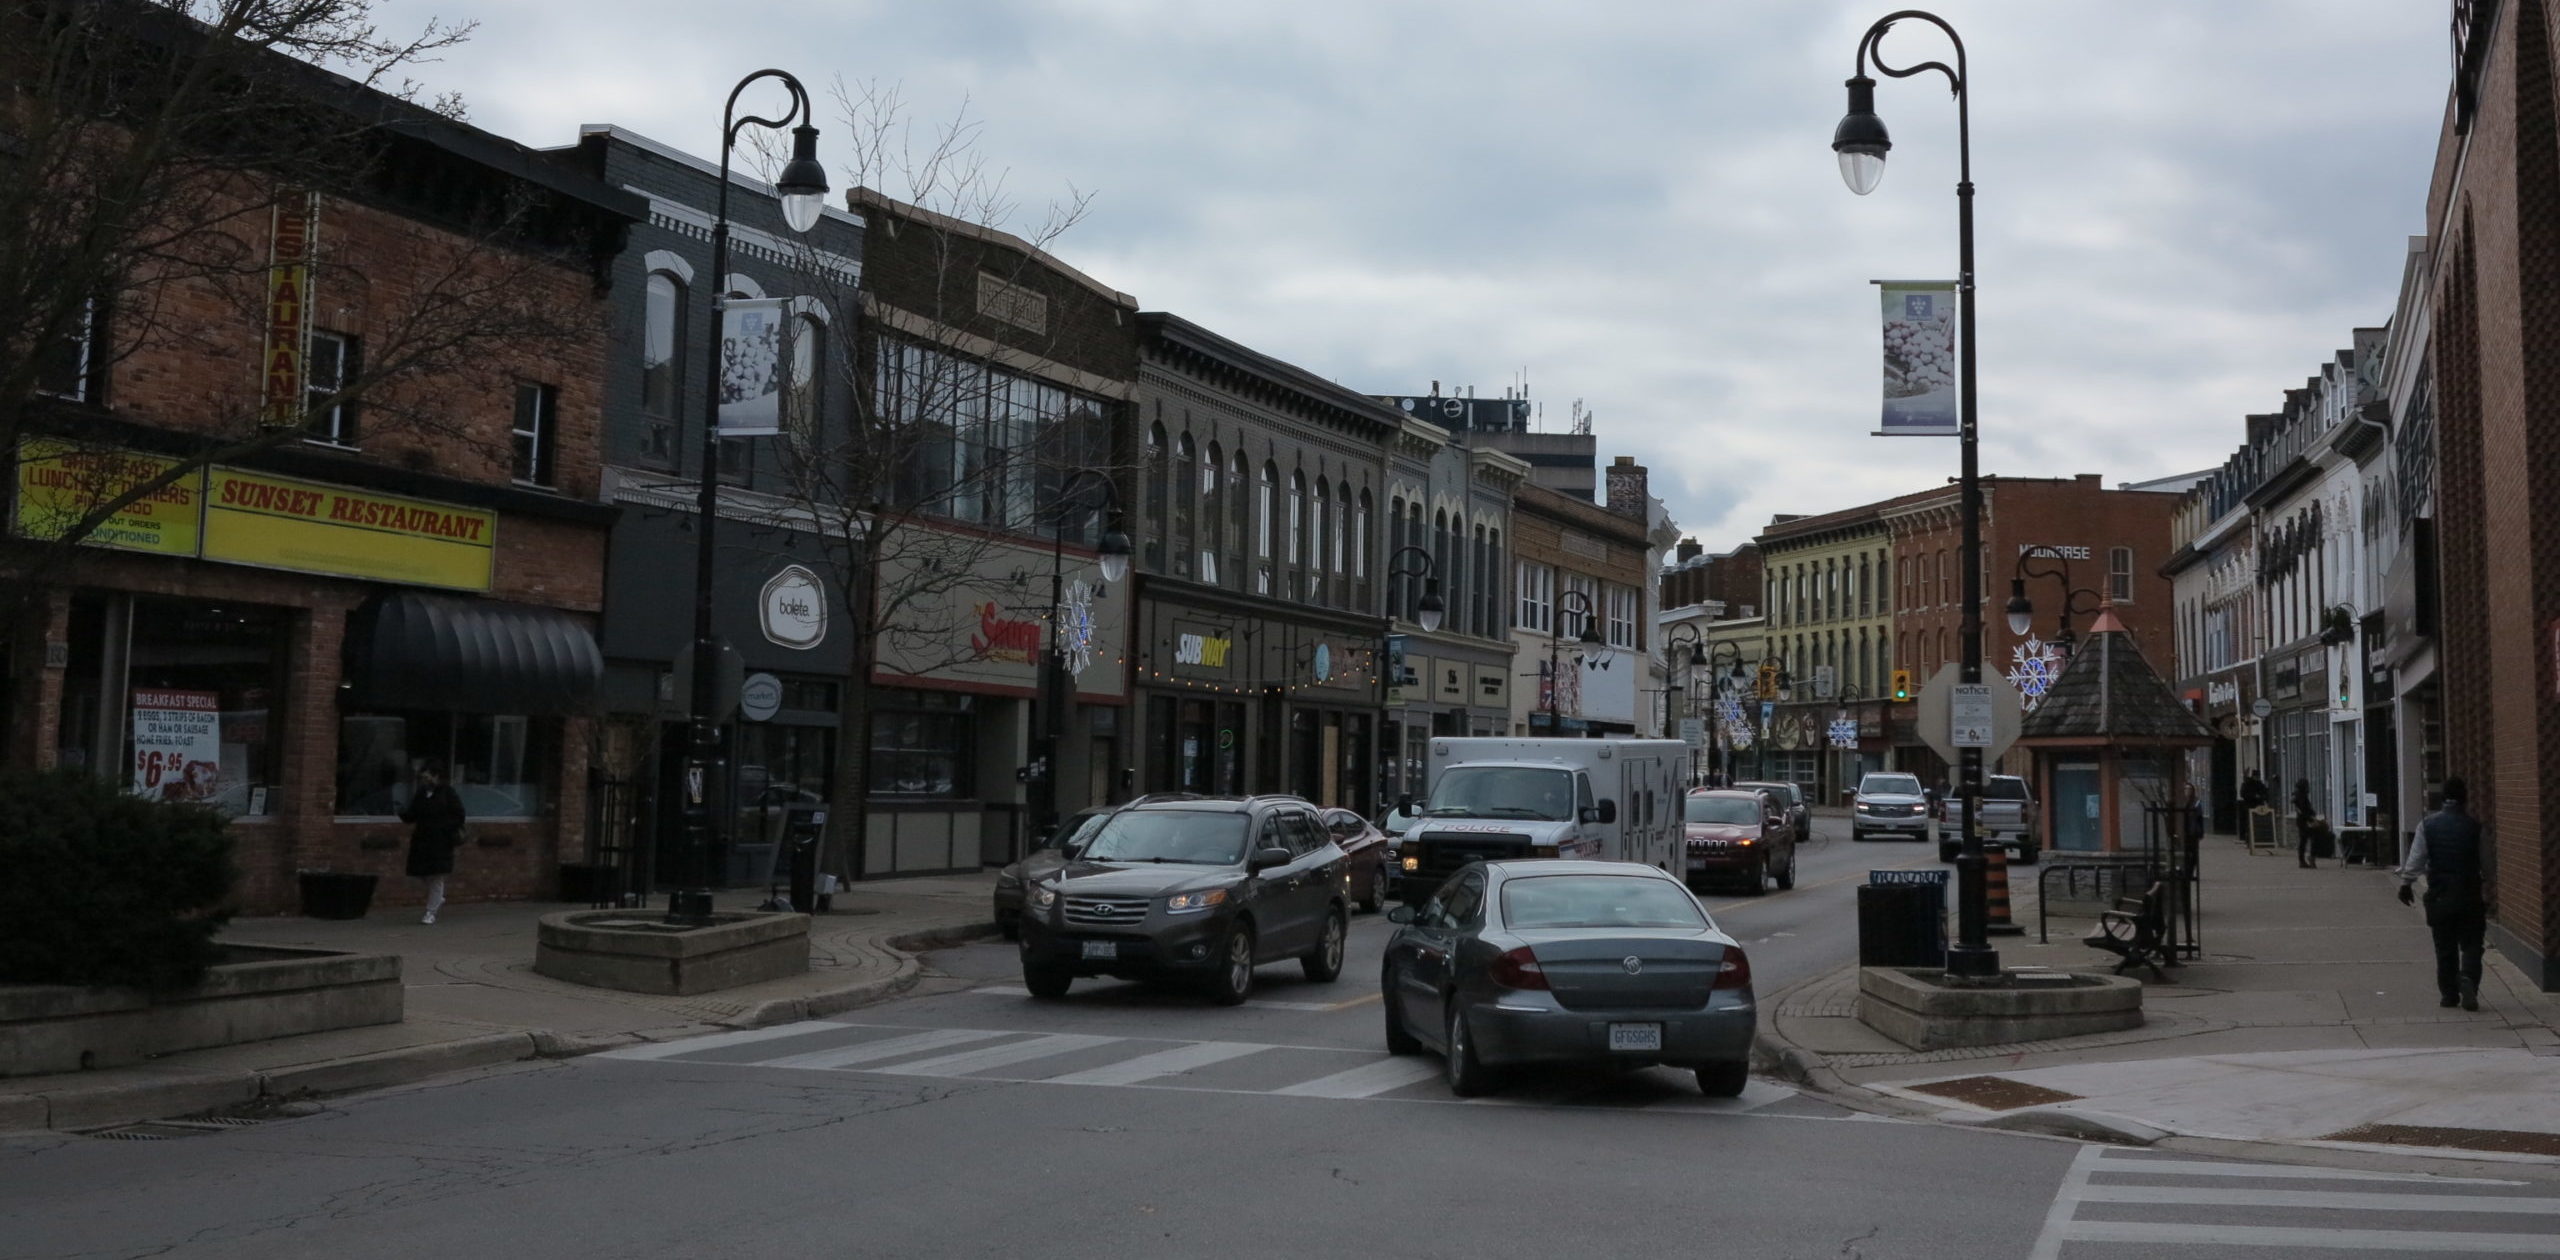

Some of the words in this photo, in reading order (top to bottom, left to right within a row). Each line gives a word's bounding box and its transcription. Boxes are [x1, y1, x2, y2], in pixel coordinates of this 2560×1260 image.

[221, 479, 324, 516] SUNSET
[329, 497, 485, 541] RESTAURANT
[128, 519, 161, 530] ORDERS
[91, 529, 160, 544] ONDITIONED
[1175, 633, 1231, 667] SUBWAY
[1955, 686, 1990, 695] NOTICE
[136, 693, 186, 707] BREAKFAST
[187, 696, 217, 709] SPECIAL
[188, 713, 196, 722] OF
[148, 724, 157, 733] OR
[158, 724, 172, 734] HAM
[174, 724, 182, 734] OR
[183, 725, 209, 735] SAUSAGE
[136, 736, 154, 745] HOME
[175, 736, 194, 746] TOAST
[137, 749, 183, 788] $6.95
[1442, 824, 1513, 834] POLICE
